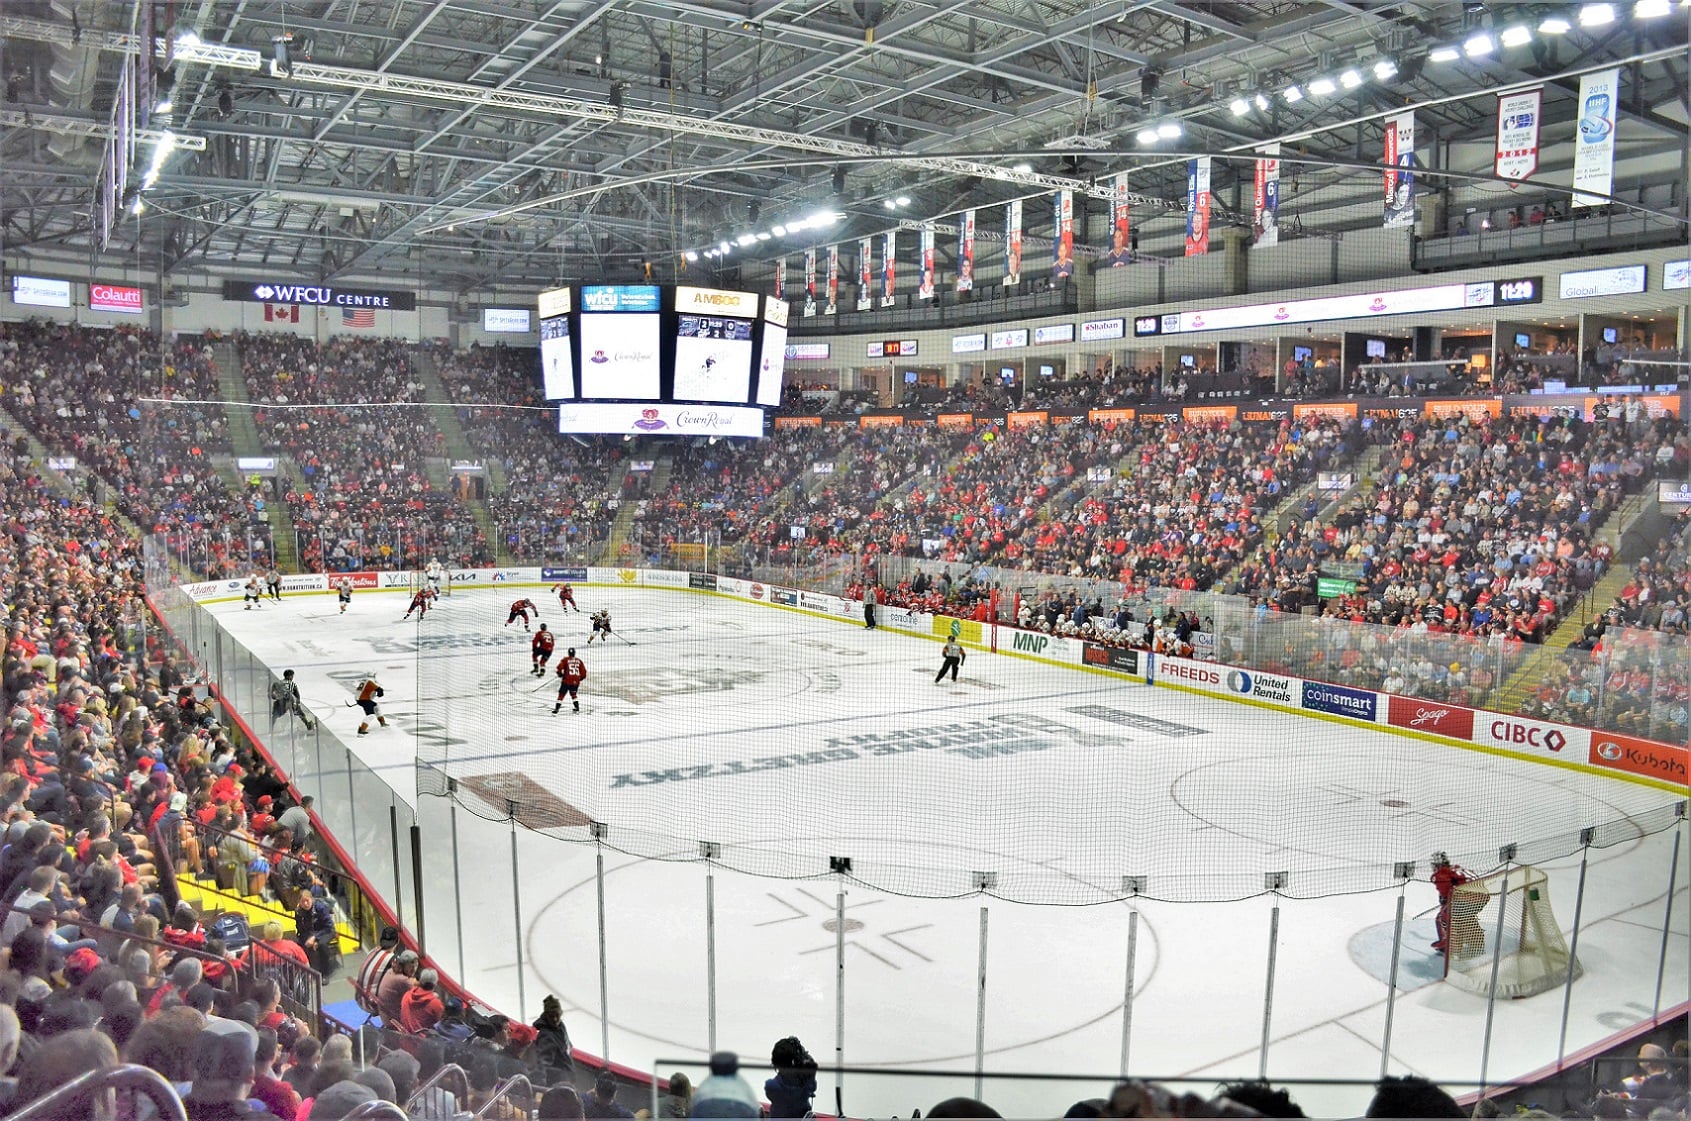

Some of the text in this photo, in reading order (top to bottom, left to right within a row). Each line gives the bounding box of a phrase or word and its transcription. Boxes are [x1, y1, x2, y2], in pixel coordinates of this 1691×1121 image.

[1589, 84, 1608, 94] 2013
[1589, 98, 1607, 107] IIHF
[1267, 182, 1274, 195] 6
[1386, 173, 1394, 204] Marcel
[1199, 193, 1206, 207] 6
[92, 286, 141, 302] Colautti
[274, 285, 390, 307] WFCU CENTRE
[584, 288, 618, 305] wfcu
[1566, 285, 1597, 297] Global
[701, 320, 707, 328] 2
[676, 410, 706, 427] Crown
[1013, 632, 1048, 654] MNP
[568, 663, 580, 676] 55
[1161, 663, 1220, 684] FREEDS
[1253, 674, 1289, 690] United
[1253, 688, 1291, 702] Rentals
[1307, 688, 1371, 711] coinsmart
[1410, 707, 1450, 726] Spago
[1491, 721, 1541, 747] CIBC
[608, 748, 860, 789] GRETZKY
[1626, 748, 1686, 775] Kubota
